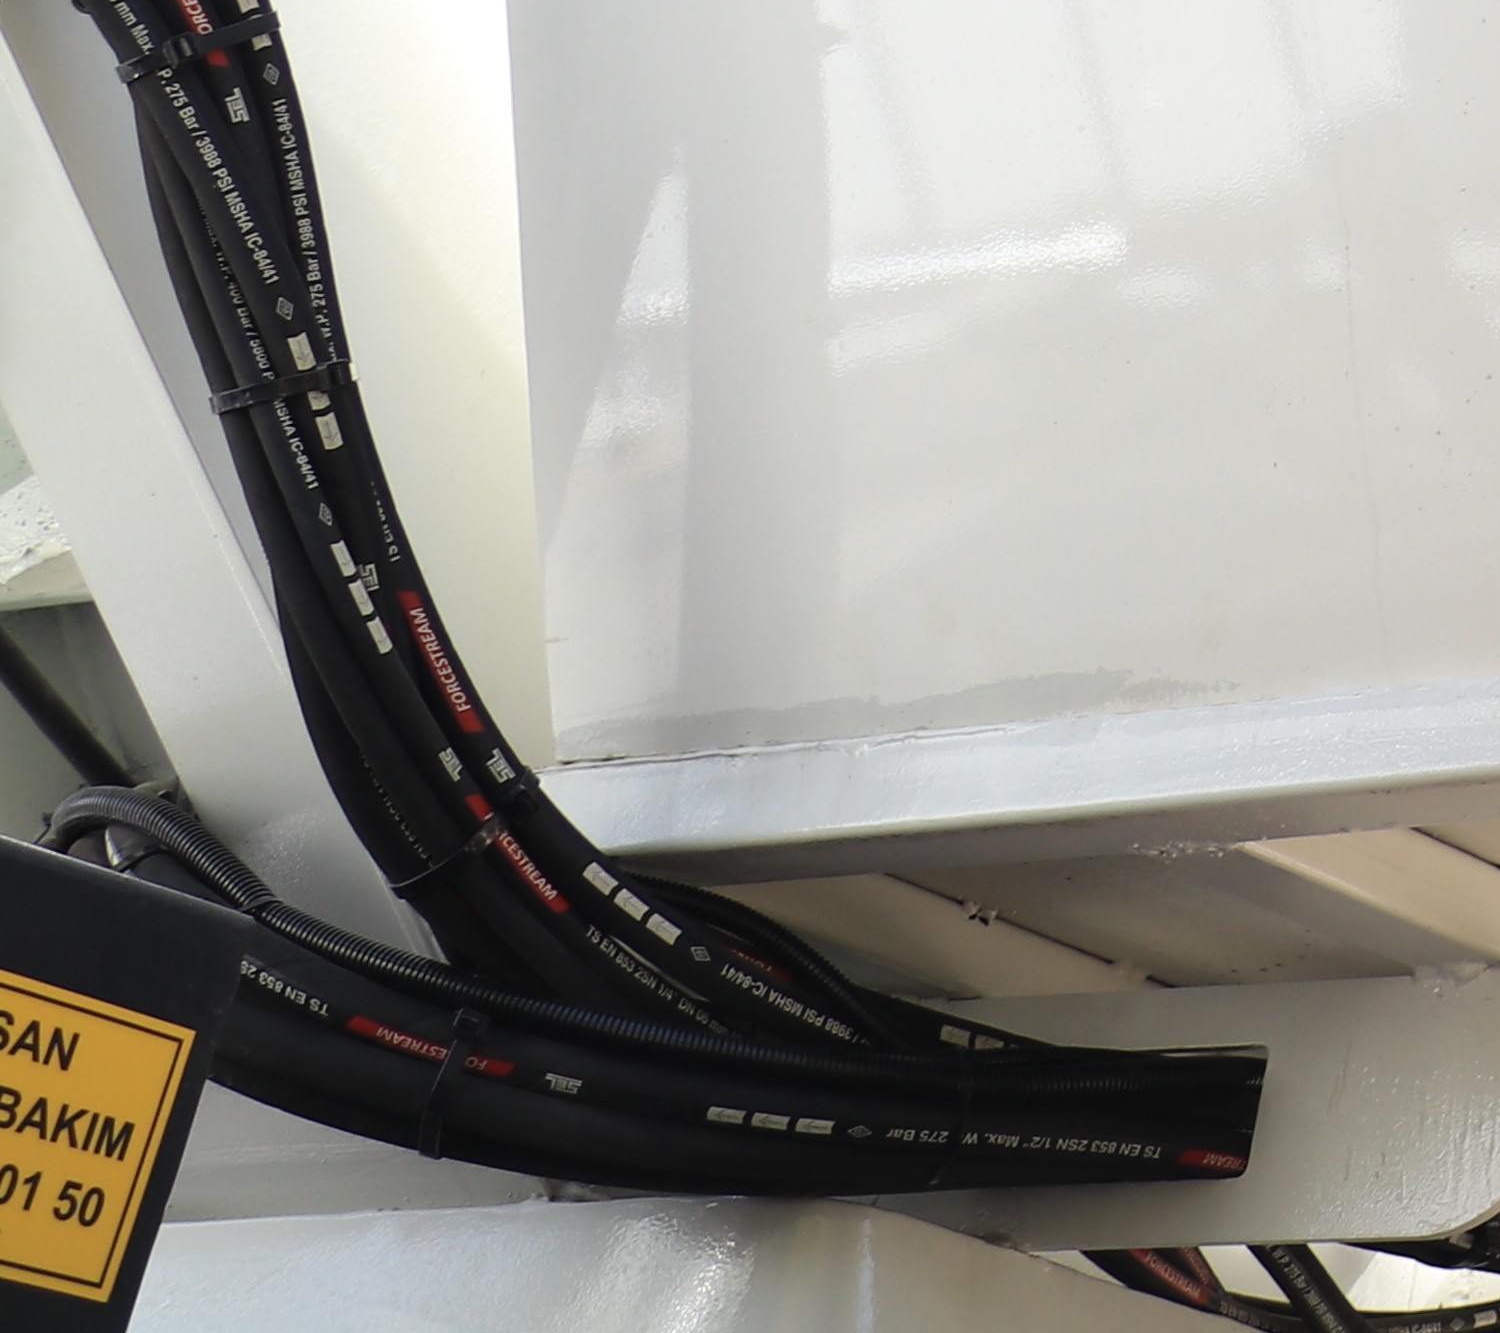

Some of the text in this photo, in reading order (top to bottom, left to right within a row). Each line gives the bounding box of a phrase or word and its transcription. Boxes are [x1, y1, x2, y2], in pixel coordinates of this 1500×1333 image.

[272, 98, 297, 150] IC-84/41
[113, 0, 138, 26] mm
[131, 23, 154, 55] Max.
[165, 83, 188, 108] 275
[179, 104, 200, 130] Bar
[196, 136, 222, 169] 3988
[212, 167, 234, 193] PSI
[224, 191, 254, 234] MSHA
[244, 232, 280, 285] IC-84/41
[285, 149, 305, 191] MSHA
[291, 193, 309, 216] PSI
[297, 217, 316, 249] 3988
[306, 258, 322, 282] Bar
[309, 283, 326, 308] 275
[409, 607, 471, 712] FORCESTREAM
[585, 924, 601, 944] TS
[599, 938, 618, 959] EN
[615, 951, 636, 973] 853
[634, 966, 659, 990] 2SN
[677, 997, 695, 1016] DN
[720, 963, 769, 998] IC-84/41
[258, 971, 284, 994] 853
[284, 985, 307, 1005] EN
[767, 990, 804, 1017] MSHA
[309, 998, 329, 1017] TS
[803, 1007, 826, 1027] PSI
[376, 1026, 489, 1071] FOESTREAM
[0, 1087, 135, 1161] BAKIM
[885, 1128, 916, 1142] Bar
[919, 1130, 949, 1143] 275
[984, 1132, 1020, 1148] Max.
[1056, 1138, 1089, 1152] 2SN
[1090, 1140, 1118, 1154] 853
[1119, 1142, 1142, 1157] EN
[1143, 1145, 1162, 1159] TS
[53, 1180, 106, 1227] 50
